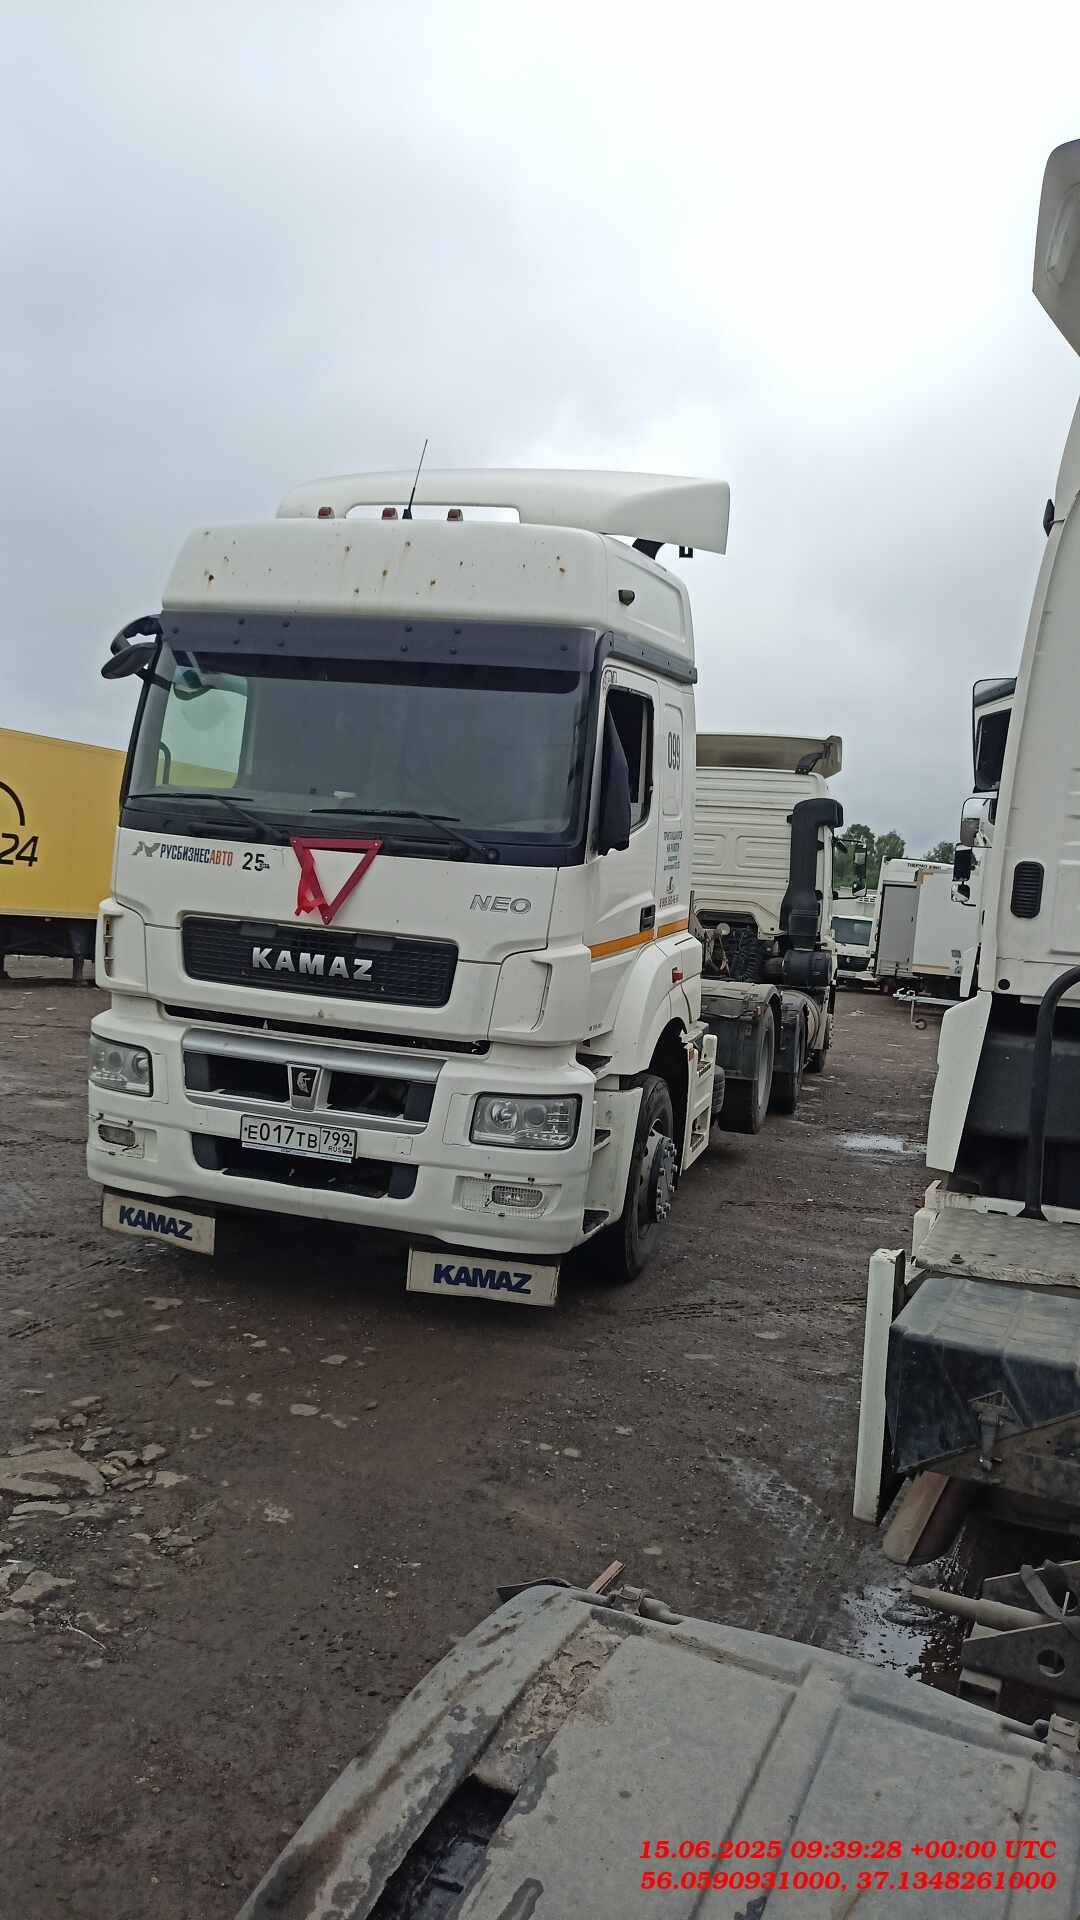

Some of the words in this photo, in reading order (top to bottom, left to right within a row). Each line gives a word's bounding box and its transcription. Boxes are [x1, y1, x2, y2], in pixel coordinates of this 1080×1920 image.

[667, 731, 681, 771] 099
[0, 832, 39, 867] 24
[159, 843, 234, 867] РУСБИЗНЕСАВТО
[469, 894, 532, 914] NEO
[252, 946, 373, 982] KAMAZ
[322, 1129, 350, 1148] 799
[328, 1145, 342, 1154] RUS
[118, 1205, 193, 1241] KAMAZ
[433, 1263, 532, 1295] KAMAZ
